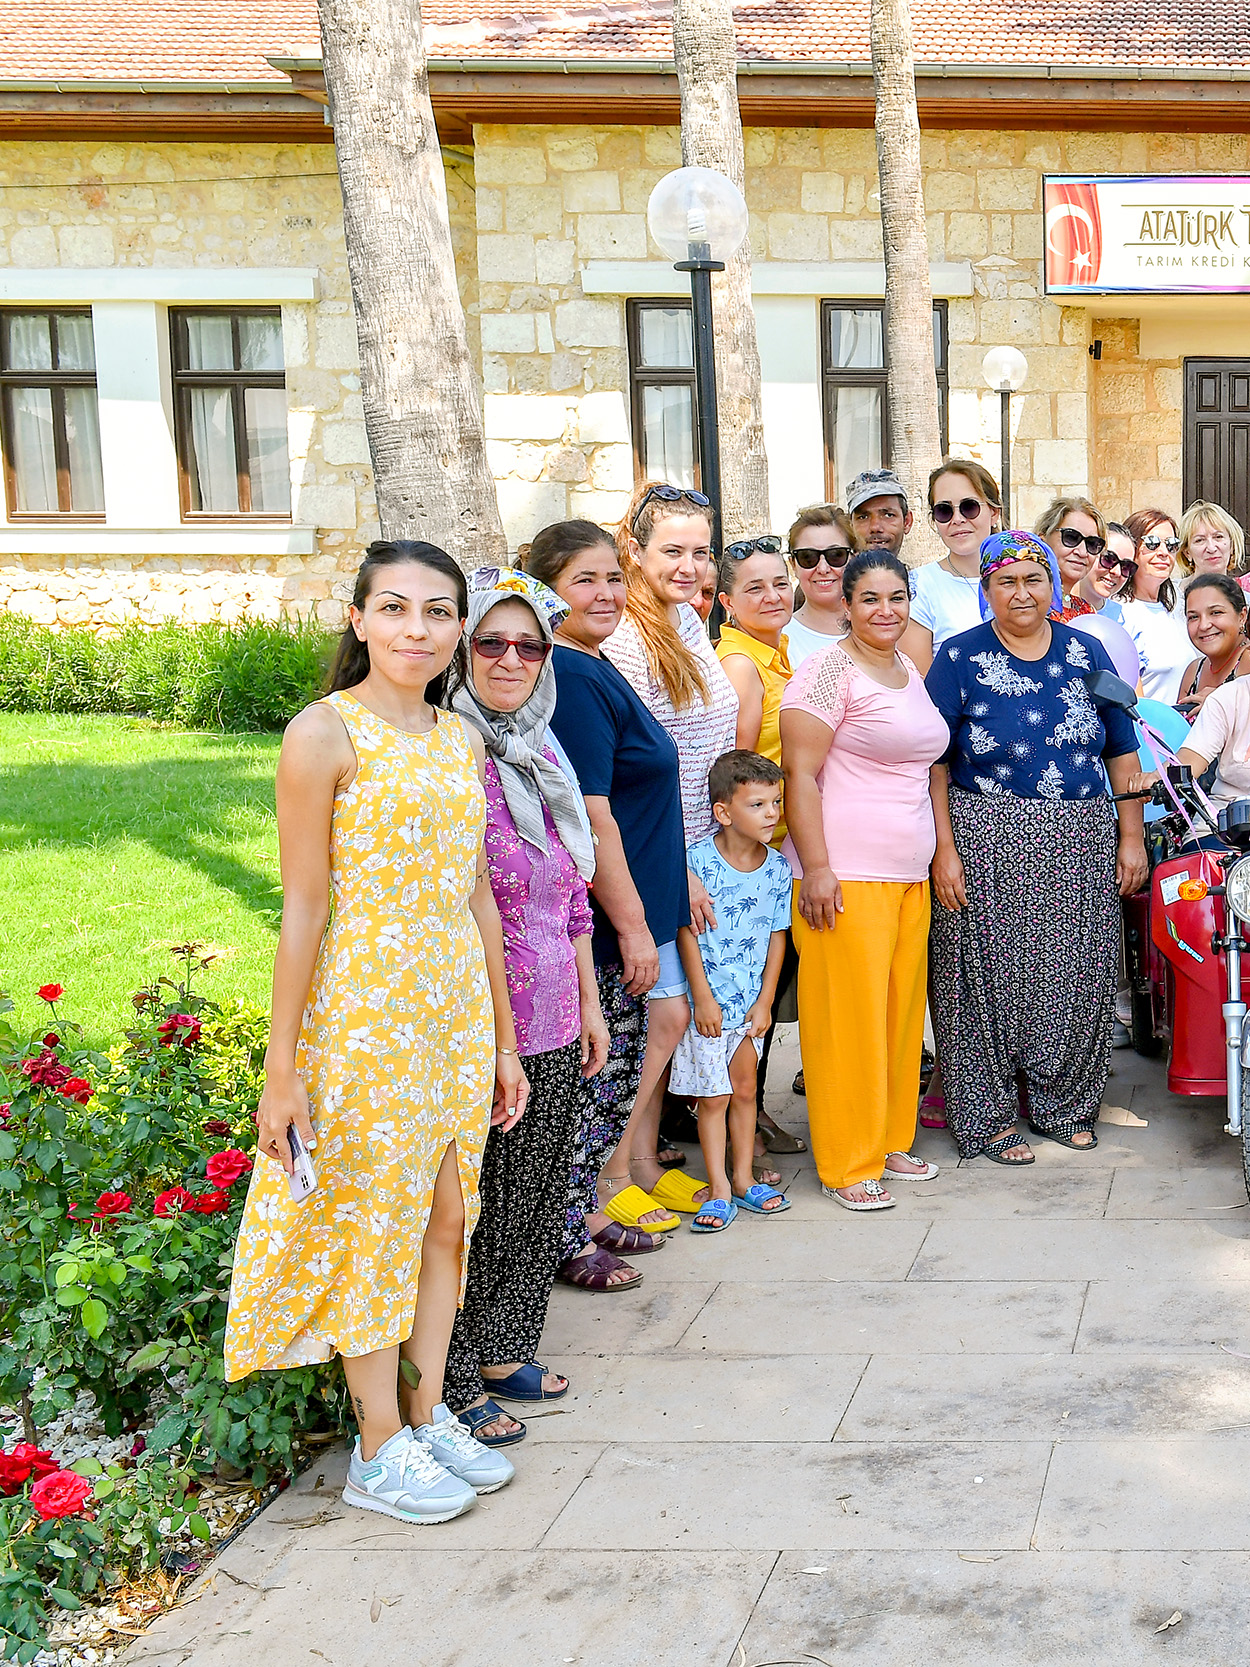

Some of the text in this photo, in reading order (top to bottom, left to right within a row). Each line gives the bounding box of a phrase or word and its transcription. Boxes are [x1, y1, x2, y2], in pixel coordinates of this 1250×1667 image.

[1139, 210, 1240, 251] ATATÜRK
[1136, 255, 1183, 267] TARIM
[1191, 254, 1235, 267] KREDİ
